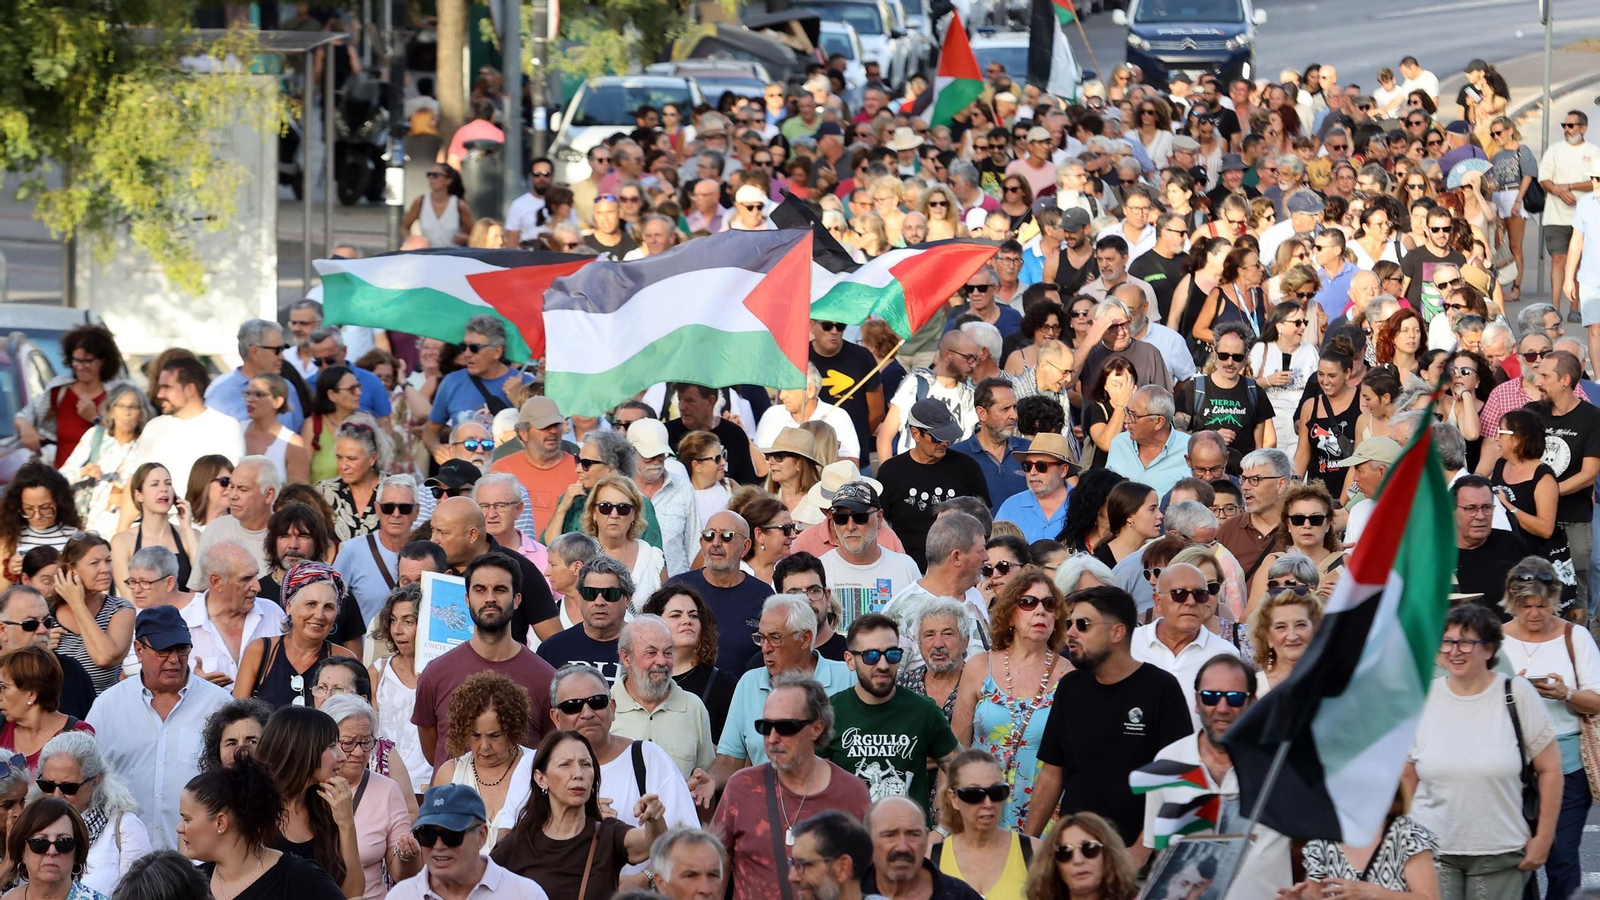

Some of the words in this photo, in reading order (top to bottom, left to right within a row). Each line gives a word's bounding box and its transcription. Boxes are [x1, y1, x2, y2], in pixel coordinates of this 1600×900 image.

[1210, 399, 1241, 407] TIERRA
[1203, 408, 1210, 417] y
[1212, 405, 1246, 415] Libertad
[423, 652, 441, 660] STO
[842, 726, 911, 749] ORGULLO
